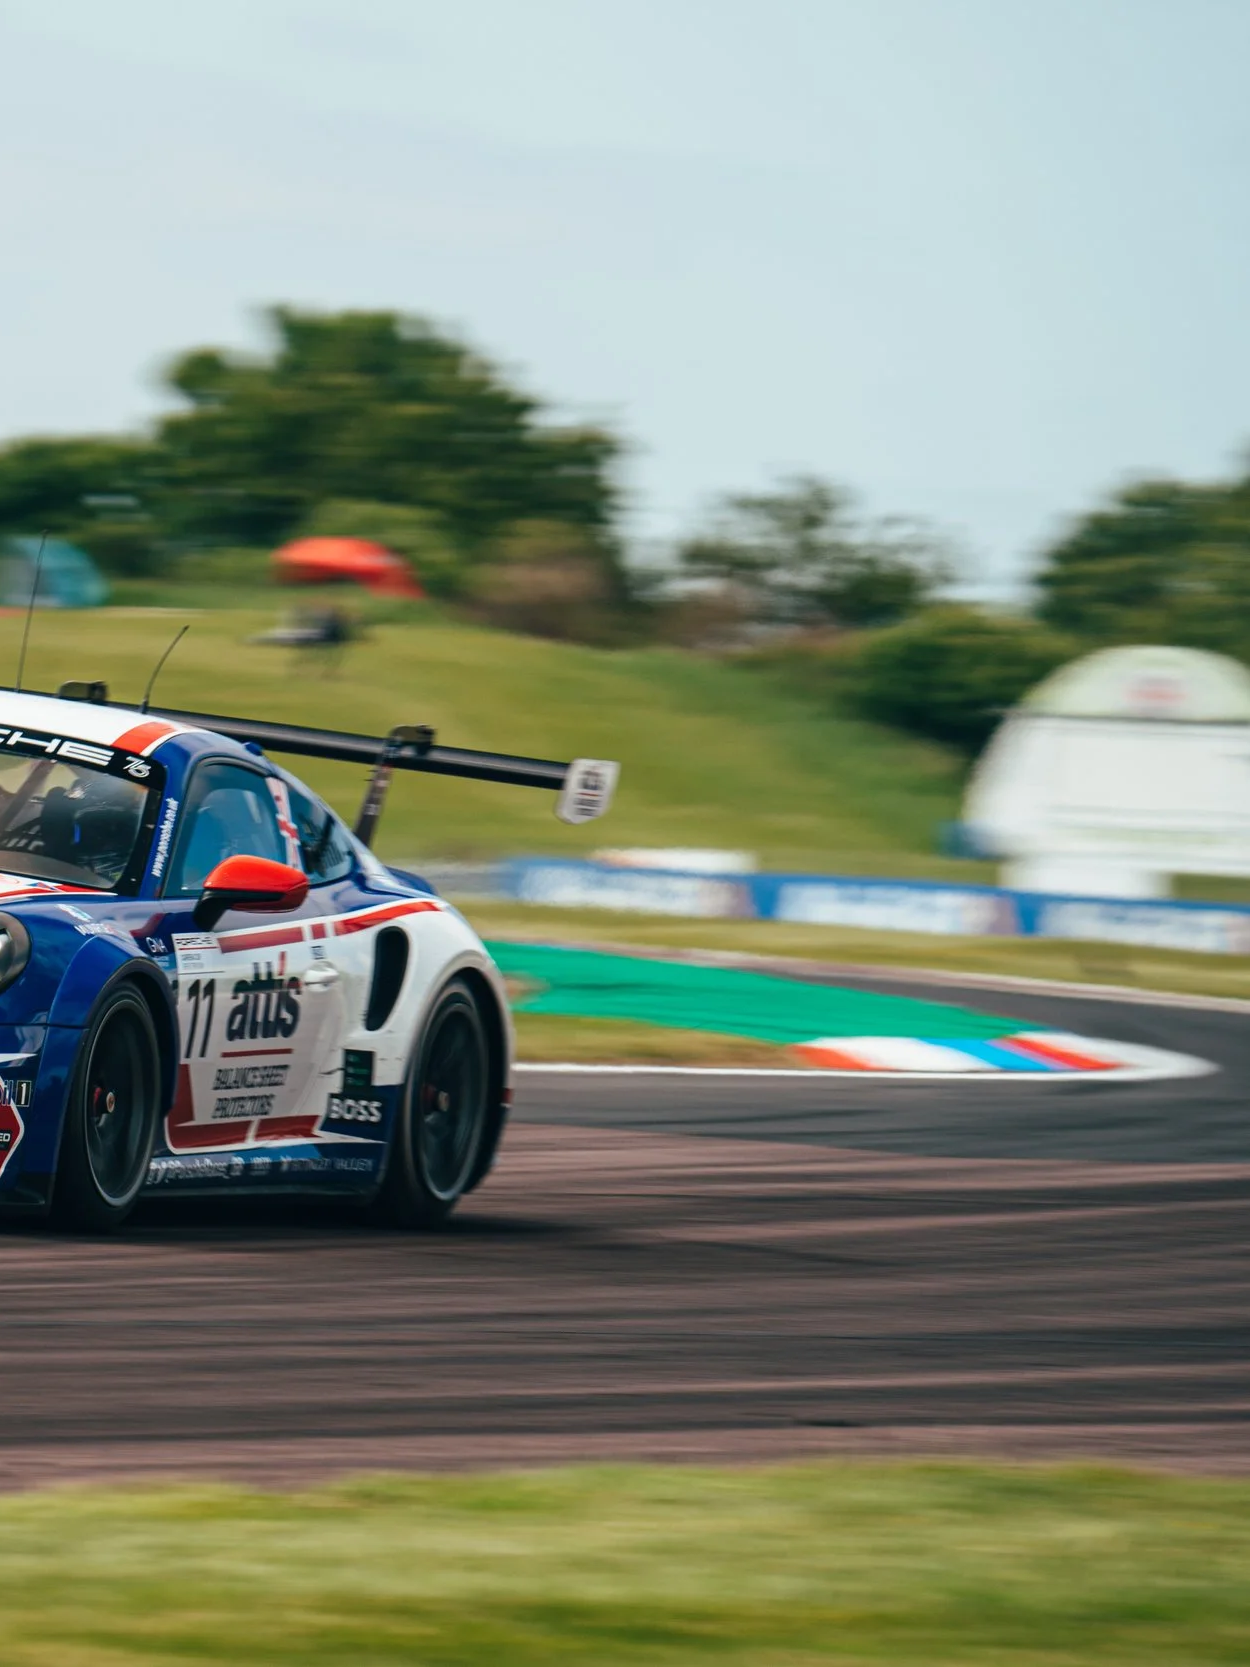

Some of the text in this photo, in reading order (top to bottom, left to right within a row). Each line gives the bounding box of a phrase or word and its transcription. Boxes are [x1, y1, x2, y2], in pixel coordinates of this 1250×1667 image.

[184, 978, 216, 1059] 11
[226, 951, 302, 1042] attis
[328, 1097, 383, 1123] BOSS
